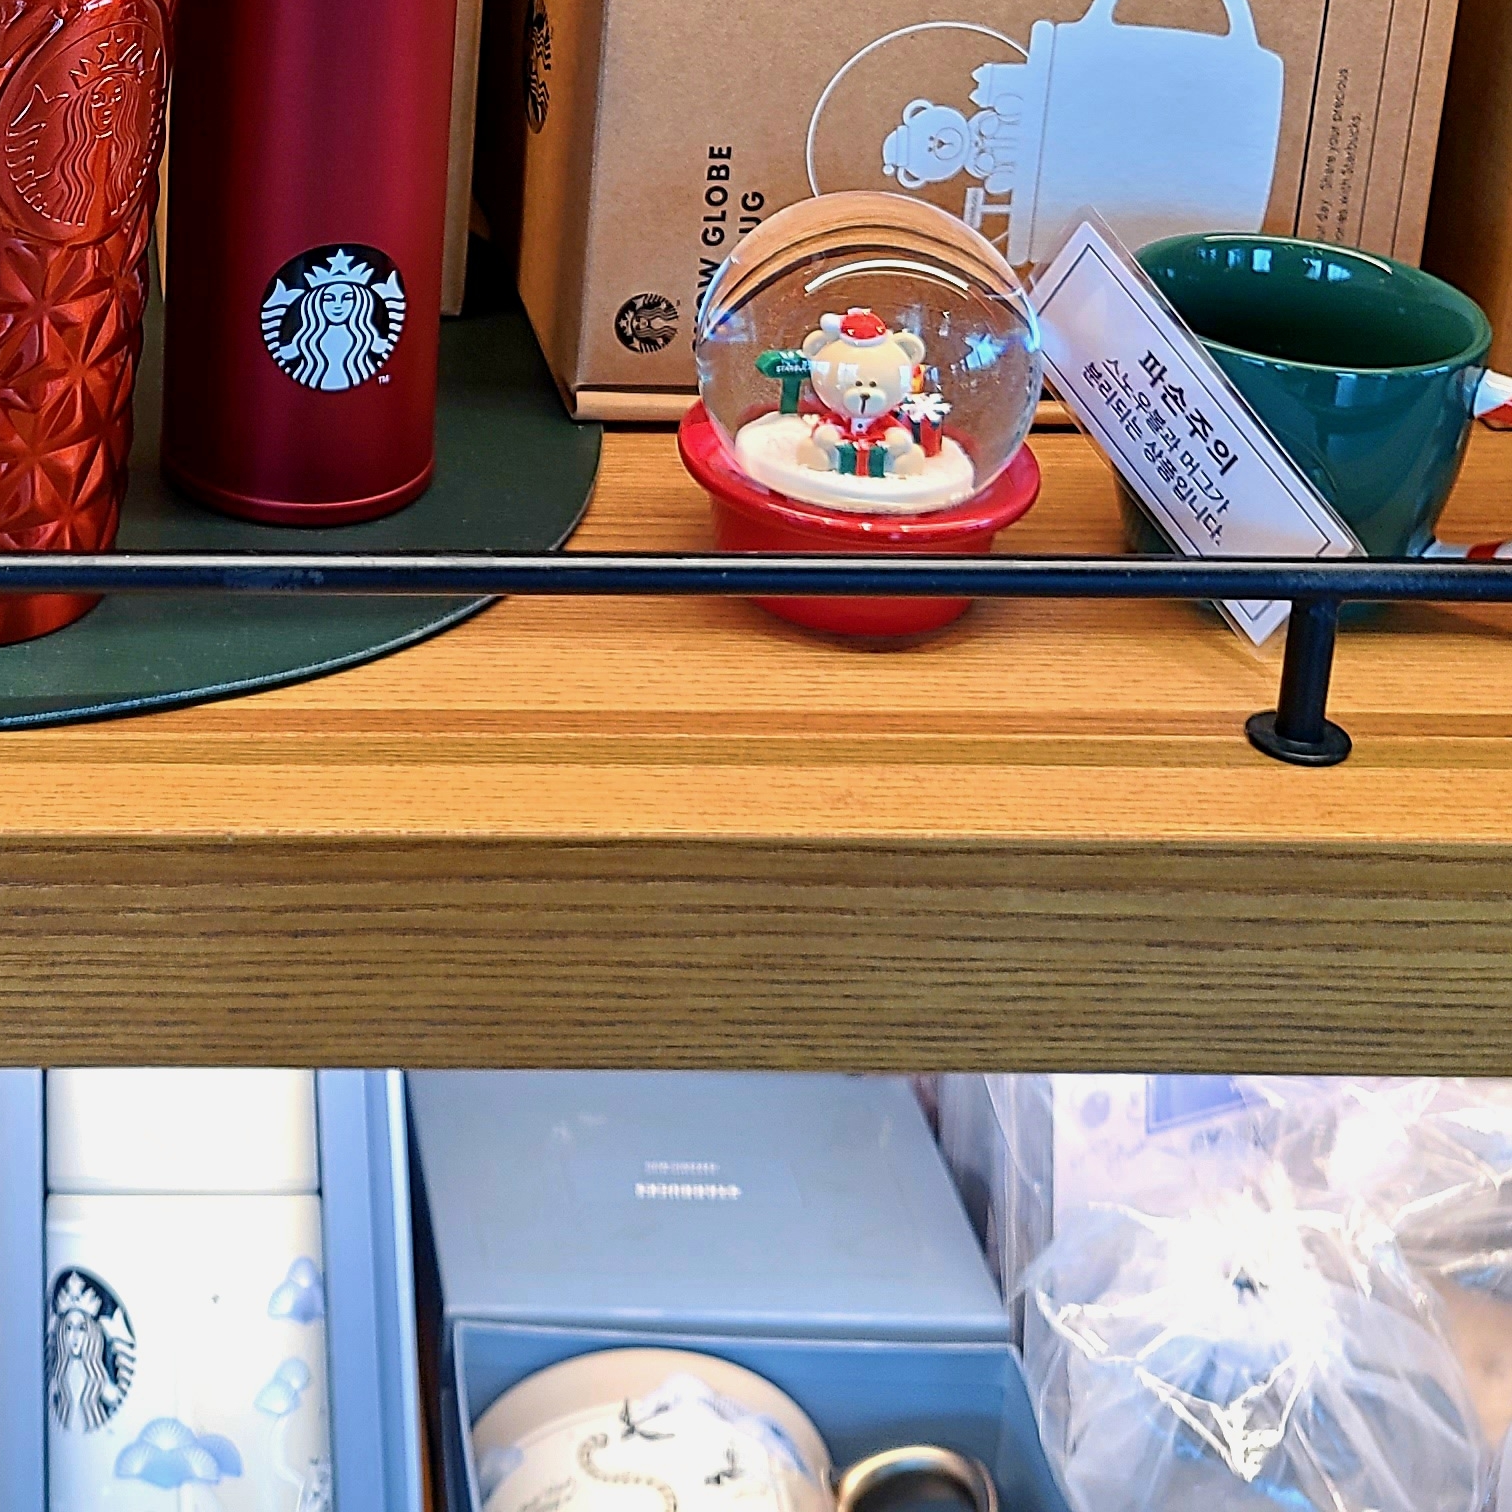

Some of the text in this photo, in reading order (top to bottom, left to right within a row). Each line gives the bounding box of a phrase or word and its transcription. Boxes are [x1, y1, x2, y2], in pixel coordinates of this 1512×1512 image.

[701, 145, 732, 247] GLOBE
[738, 191, 765, 238] UG
[1082, 361, 1224, 546] 분리되는 상품입니다.
[1102, 357, 1231, 515] 스노우볼과 머그가
[1137, 349, 1239, 477] 파손주의
